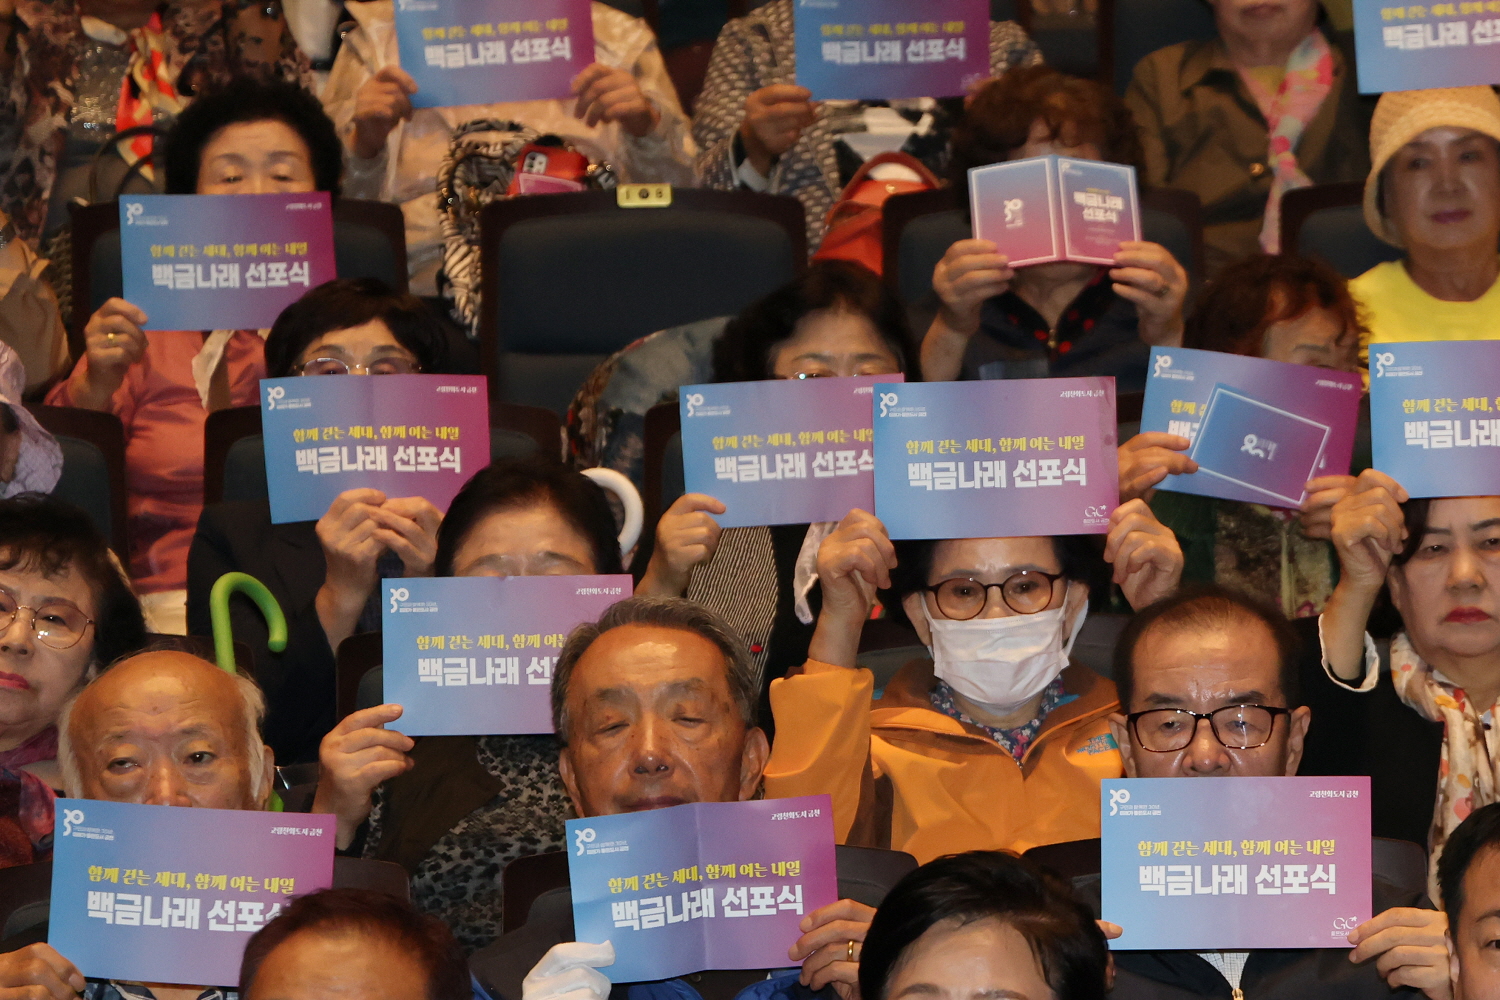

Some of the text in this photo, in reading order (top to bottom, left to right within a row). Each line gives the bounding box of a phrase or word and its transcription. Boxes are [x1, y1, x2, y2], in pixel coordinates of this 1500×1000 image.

[1383, 21, 1467, 50] 백금나래
[424, 36, 570, 69] 백금나래 선포식
[152, 261, 309, 289] 백금나래 선포식
[295, 446, 460, 473] 백금나래 선포식
[906, 440, 934, 455] 함께
[998, 437, 1027, 452] 함께
[1029, 436, 1055, 451] 여는
[1058, 435, 1084, 450] 내일
[714, 452, 806, 483] 백금나래
[908, 457, 1086, 491] 백금나래 선포식
[416, 635, 444, 649] 함께
[511, 633, 541, 648] 함께
[418, 656, 519, 685] 백금나래
[1137, 841, 1168, 856] 함께
[1240, 840, 1271, 855] 함께
[1274, 839, 1303, 855] 여는
[1306, 839, 1335, 855] 내일
[86, 866, 119, 884] 함께
[194, 872, 227, 890] 함께
[229, 875, 260, 892] 여는
[263, 876, 294, 895] 내일
[610, 874, 639, 892] 함께
[706, 863, 737, 882] 함께
[739, 860, 768, 879] 여는
[770, 856, 800, 876] 내일
[1139, 863, 1335, 896] 백금나래 선포식
[85, 891, 200, 929] 백금나래
[613, 881, 802, 930] 백금나래 선포식
